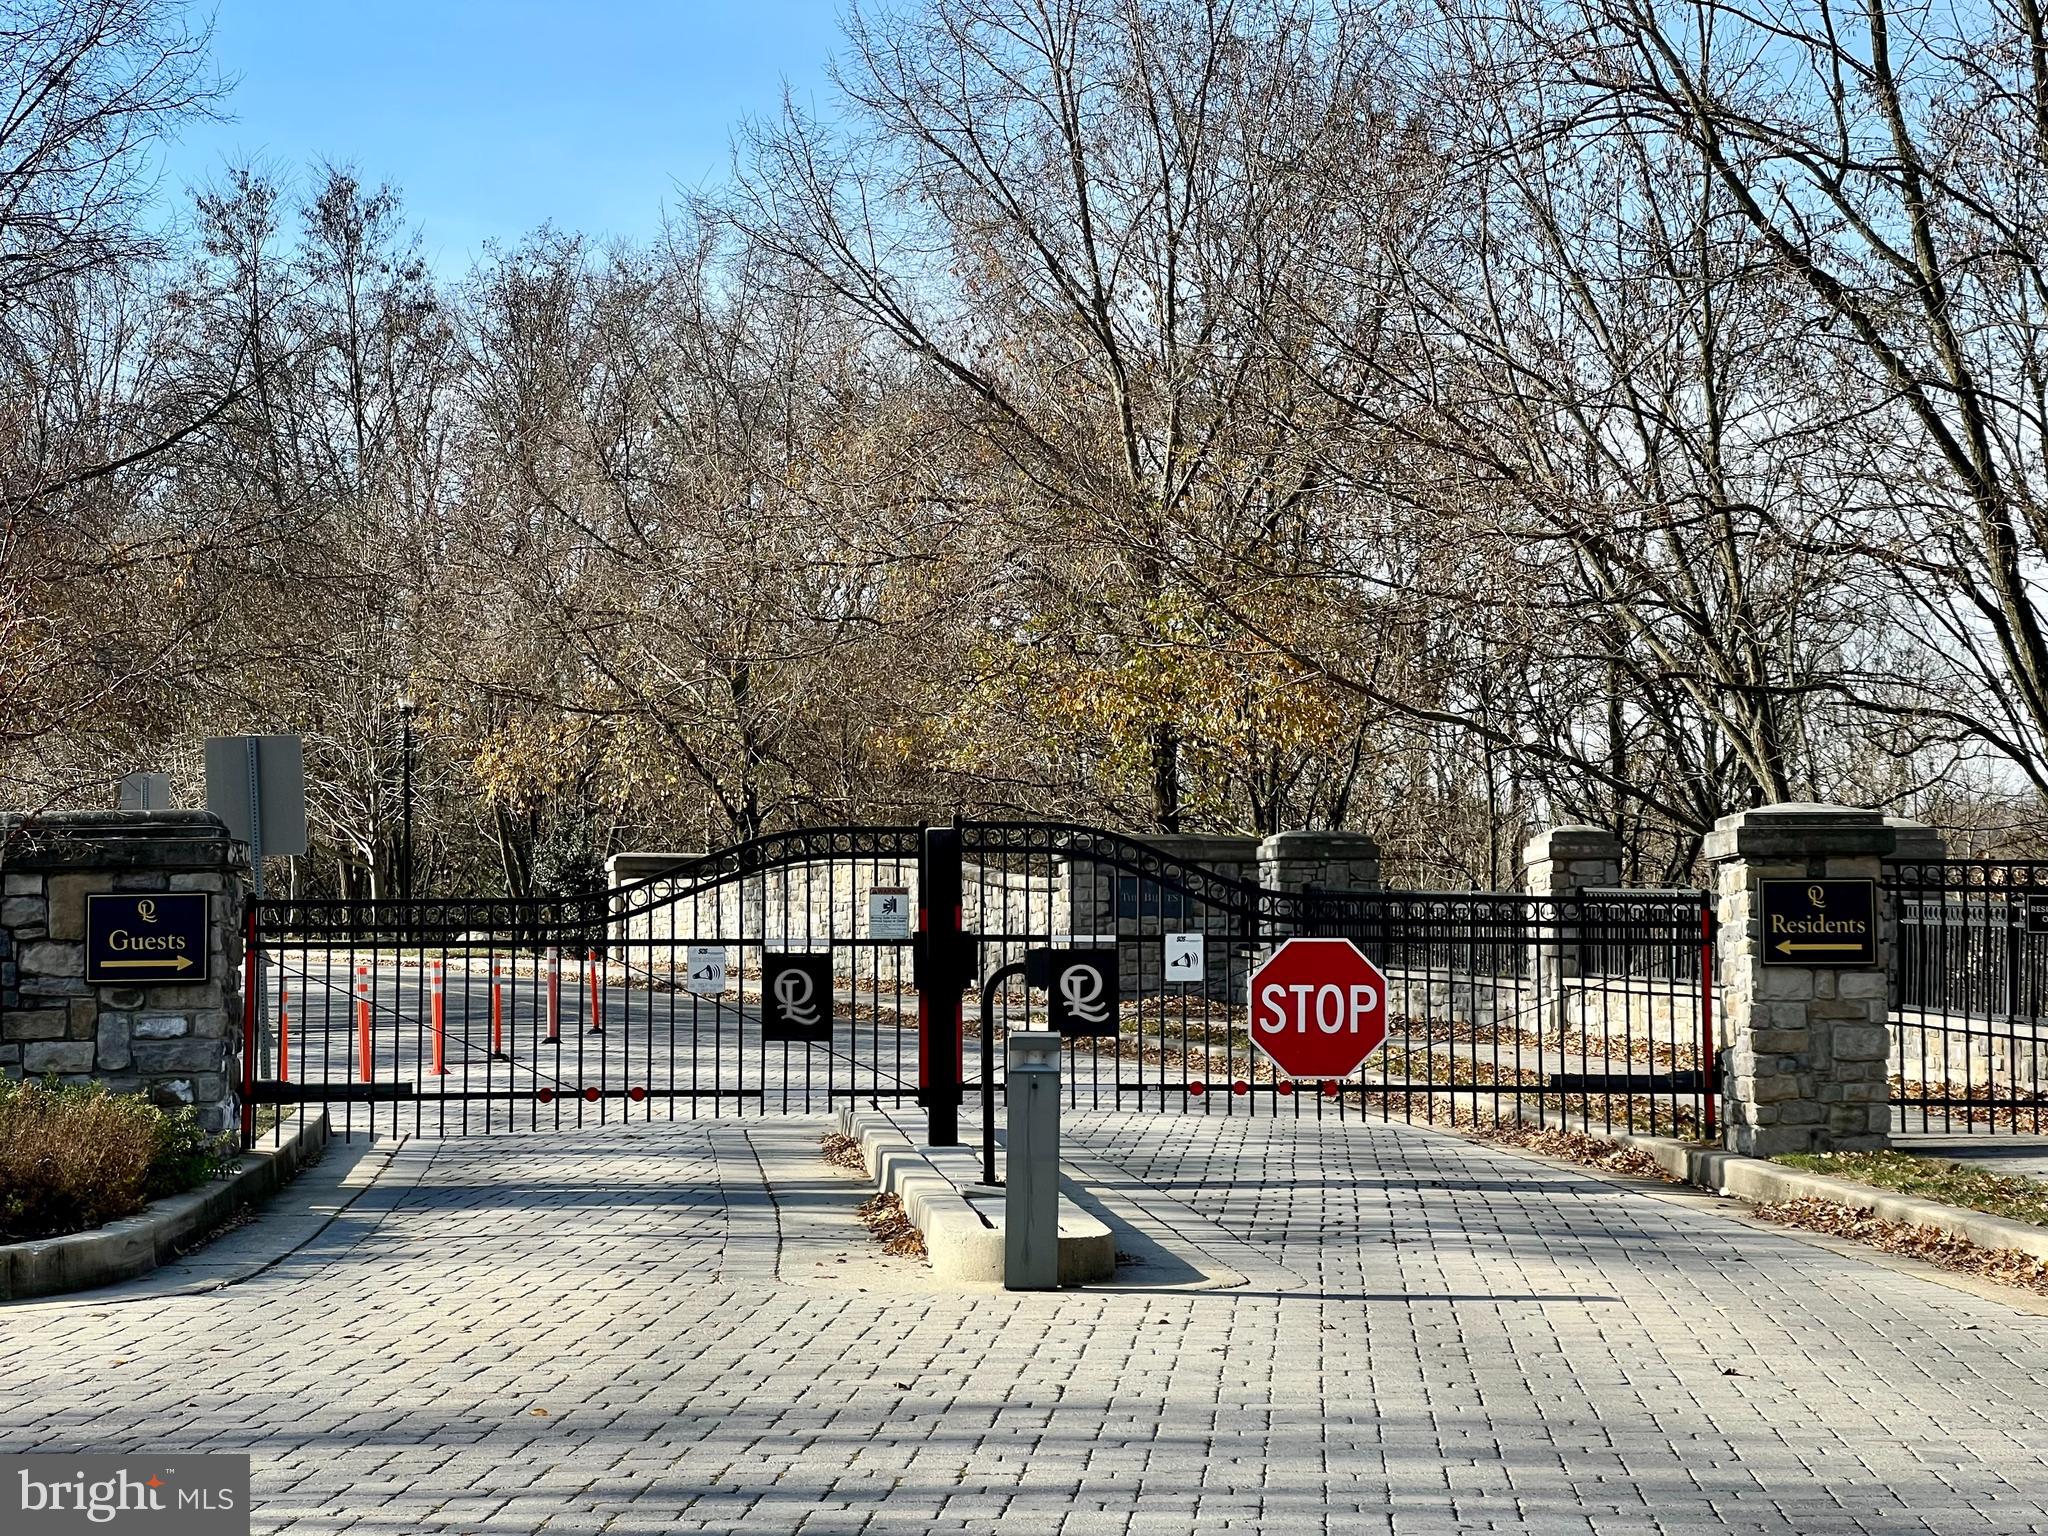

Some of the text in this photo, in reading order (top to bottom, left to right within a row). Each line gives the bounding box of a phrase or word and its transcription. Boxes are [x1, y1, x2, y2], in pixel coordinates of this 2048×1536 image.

[1771, 913, 1866, 934] Residents
[108, 929, 186, 951] Guests
[1259, 983, 1378, 1034] STOP
